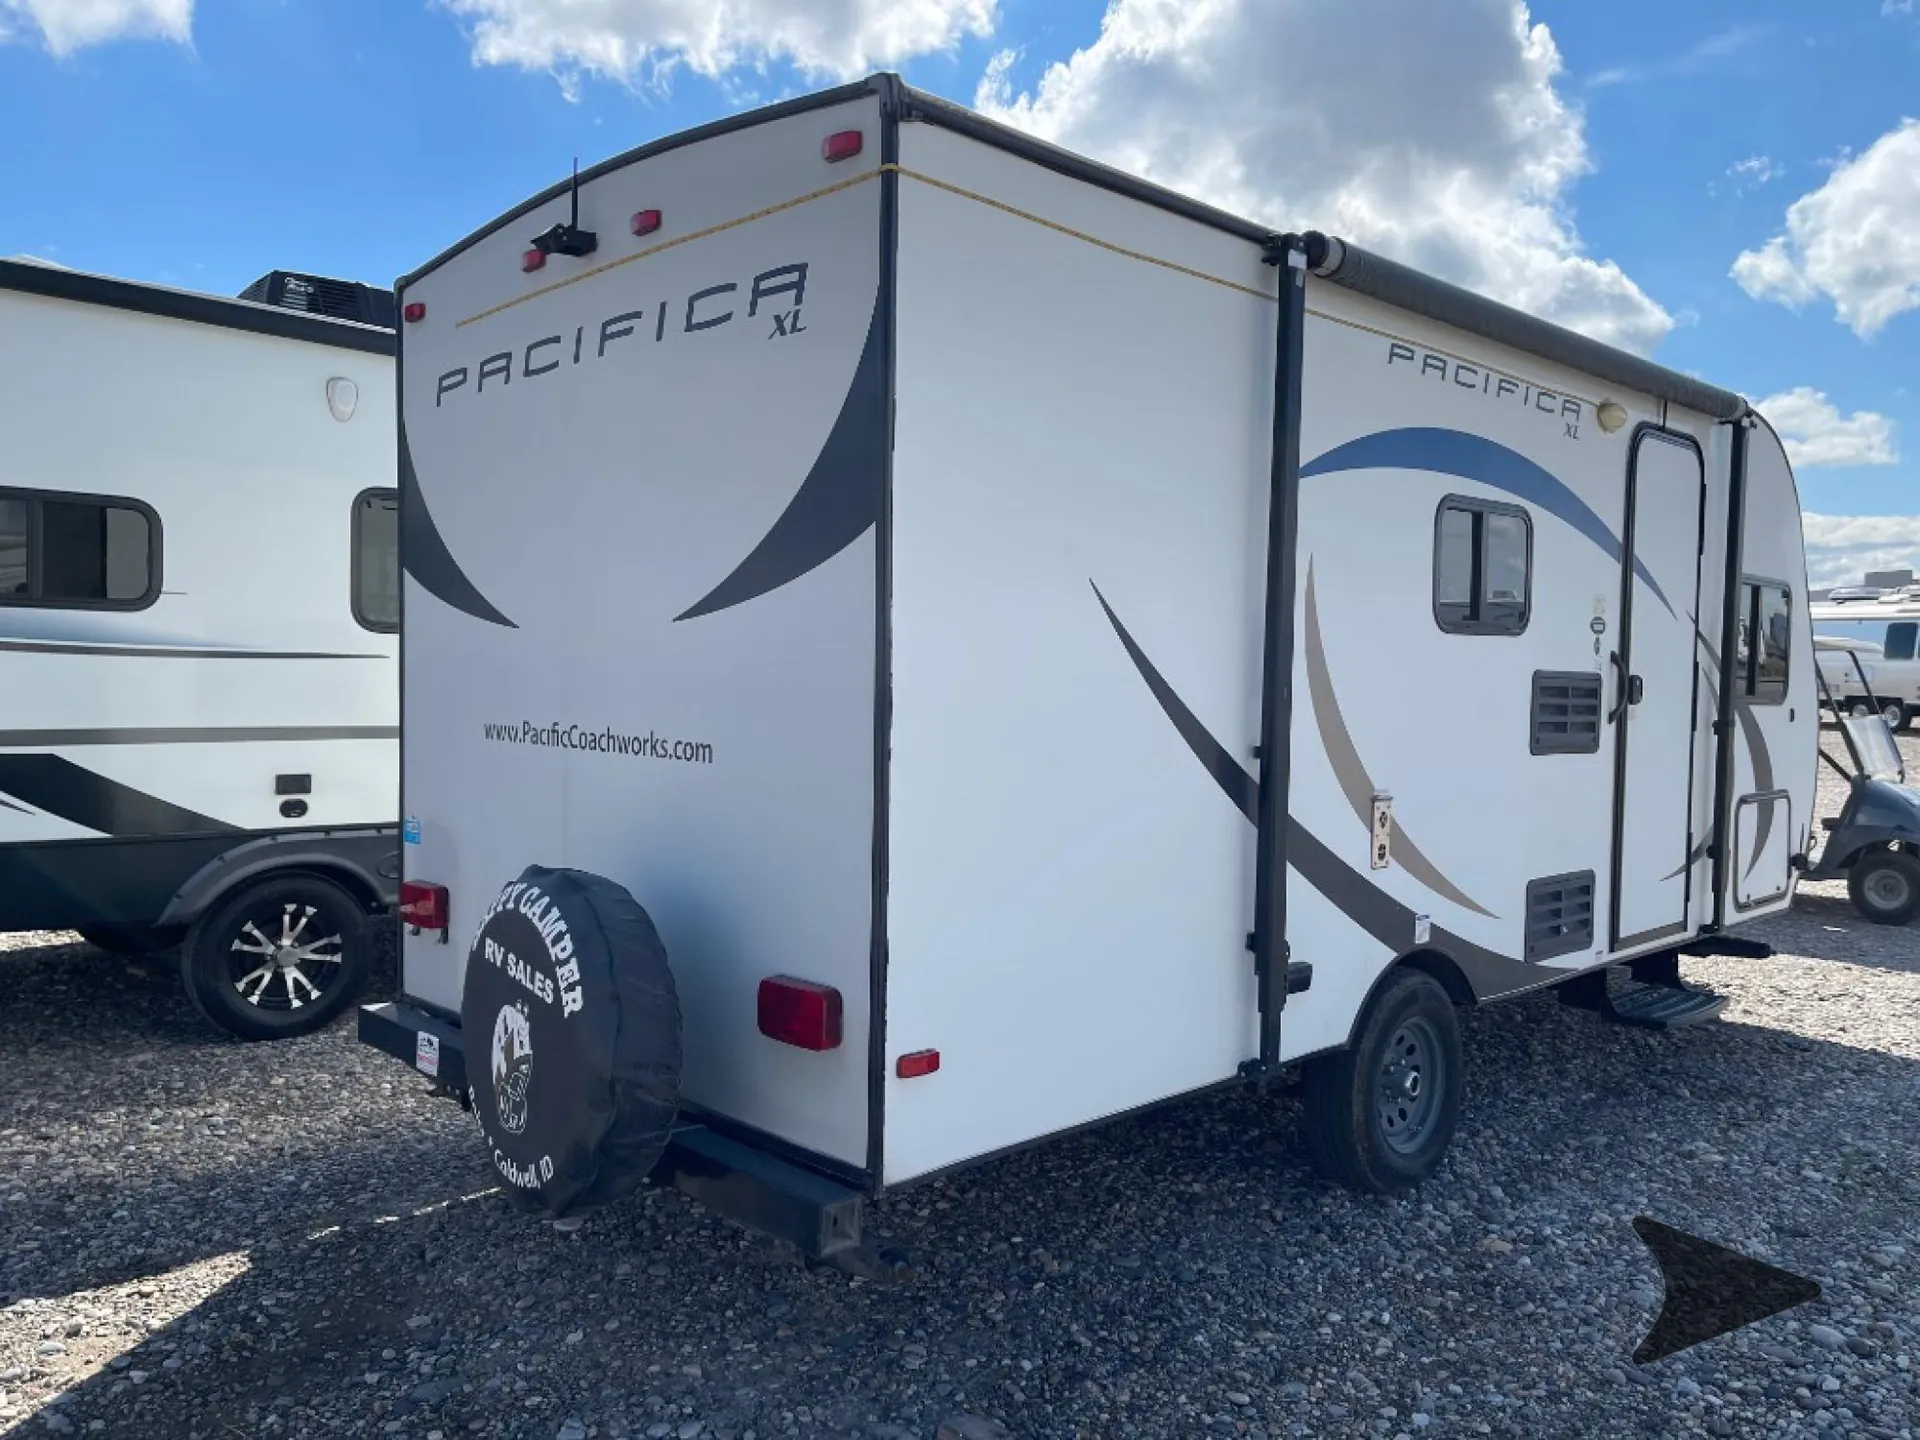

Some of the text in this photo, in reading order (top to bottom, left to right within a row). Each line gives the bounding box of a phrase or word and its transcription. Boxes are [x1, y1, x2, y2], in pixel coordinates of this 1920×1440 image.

[436, 262, 809, 407] PACIFICA
[768, 308, 807, 340] XL
[1387, 342, 1582, 421] PACIFICA
[1563, 421, 1581, 441] XL
[483, 720, 714, 764] www.PacificCoachworks.com
[472, 882, 584, 1018] PPY CAMPER
[485, 937, 554, 1004] RV SALES
